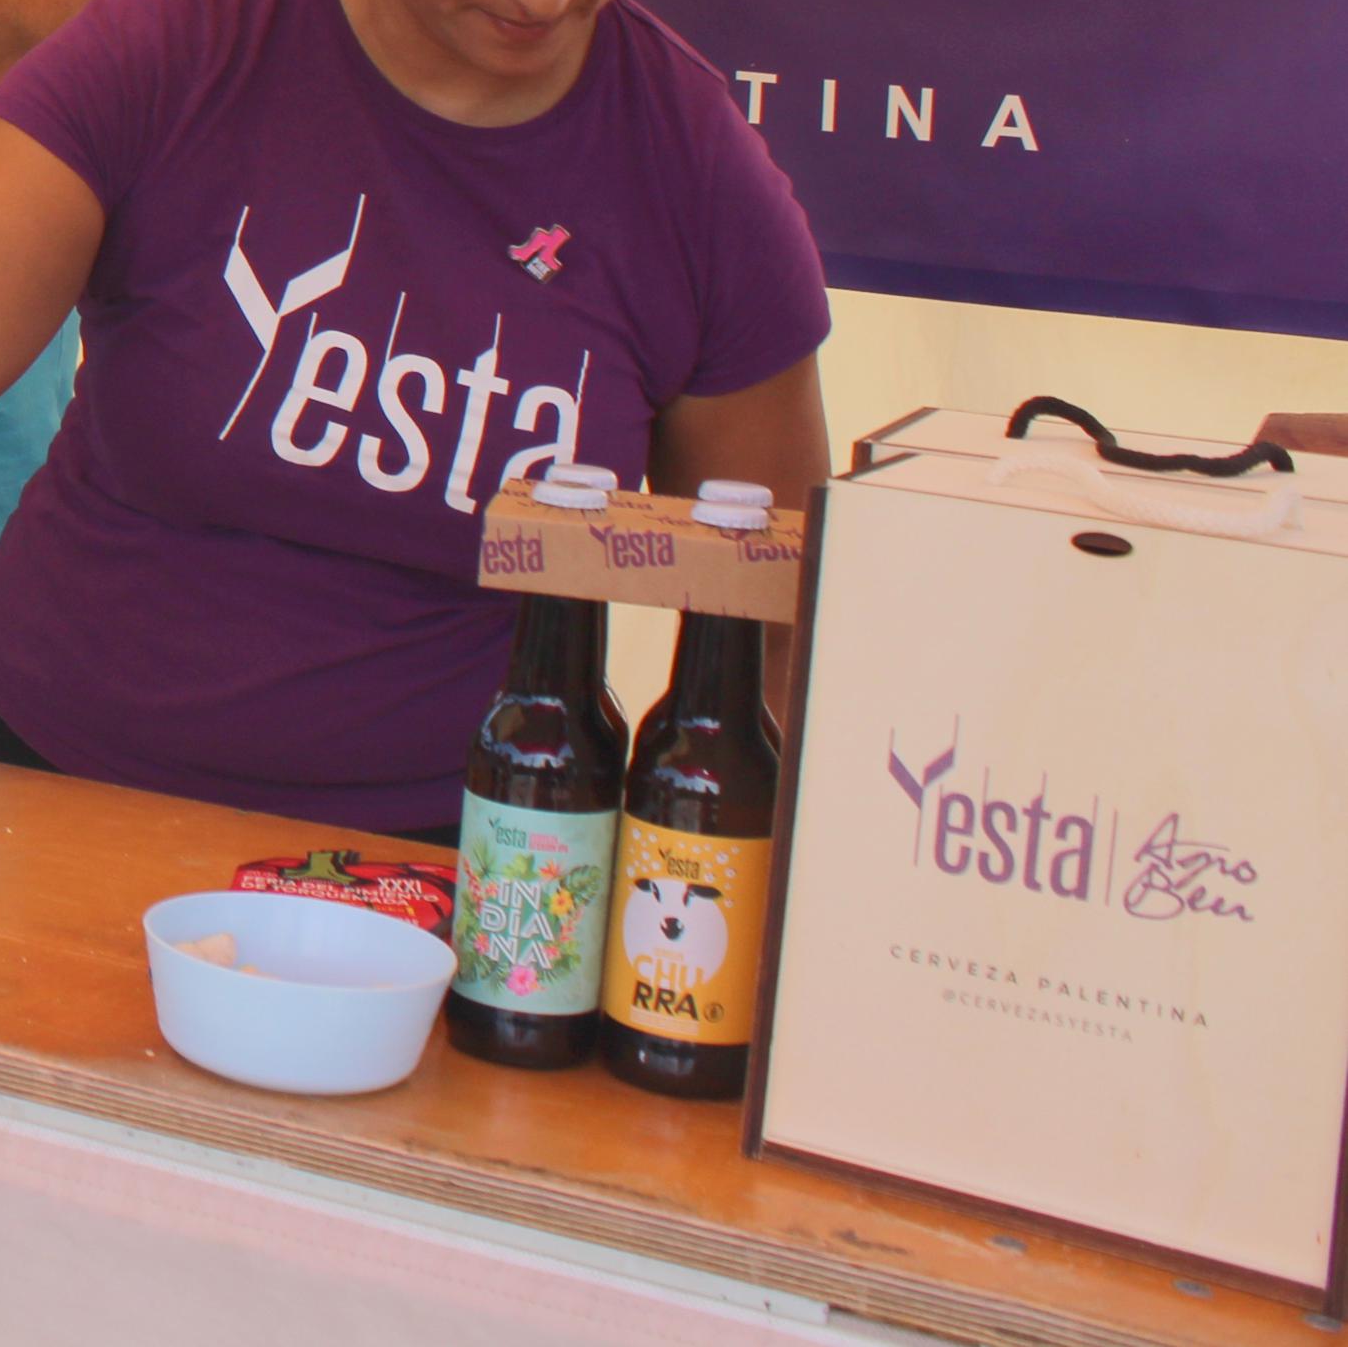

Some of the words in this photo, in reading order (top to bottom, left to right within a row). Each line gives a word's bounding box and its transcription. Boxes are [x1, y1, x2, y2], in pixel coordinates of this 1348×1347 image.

[219, 193, 589, 514] Yesta
[589, 523, 675, 578] Yesta
[888, 714, 1098, 901] Yesta
[488, 817, 527, 850] Yesta
[242, 875, 297, 886] FERIA
[301, 882, 335, 892] DEL
[377, 877, 423, 895] XXXI
[498, 879, 542, 910] IN
[481, 902, 555, 942] DIA
[486, 933, 553, 970] NA
[632, 981, 700, 1022] RRA
[889, 945, 1019, 985] CERVEZA
[1037, 977, 1208, 1029] PALENTINA
